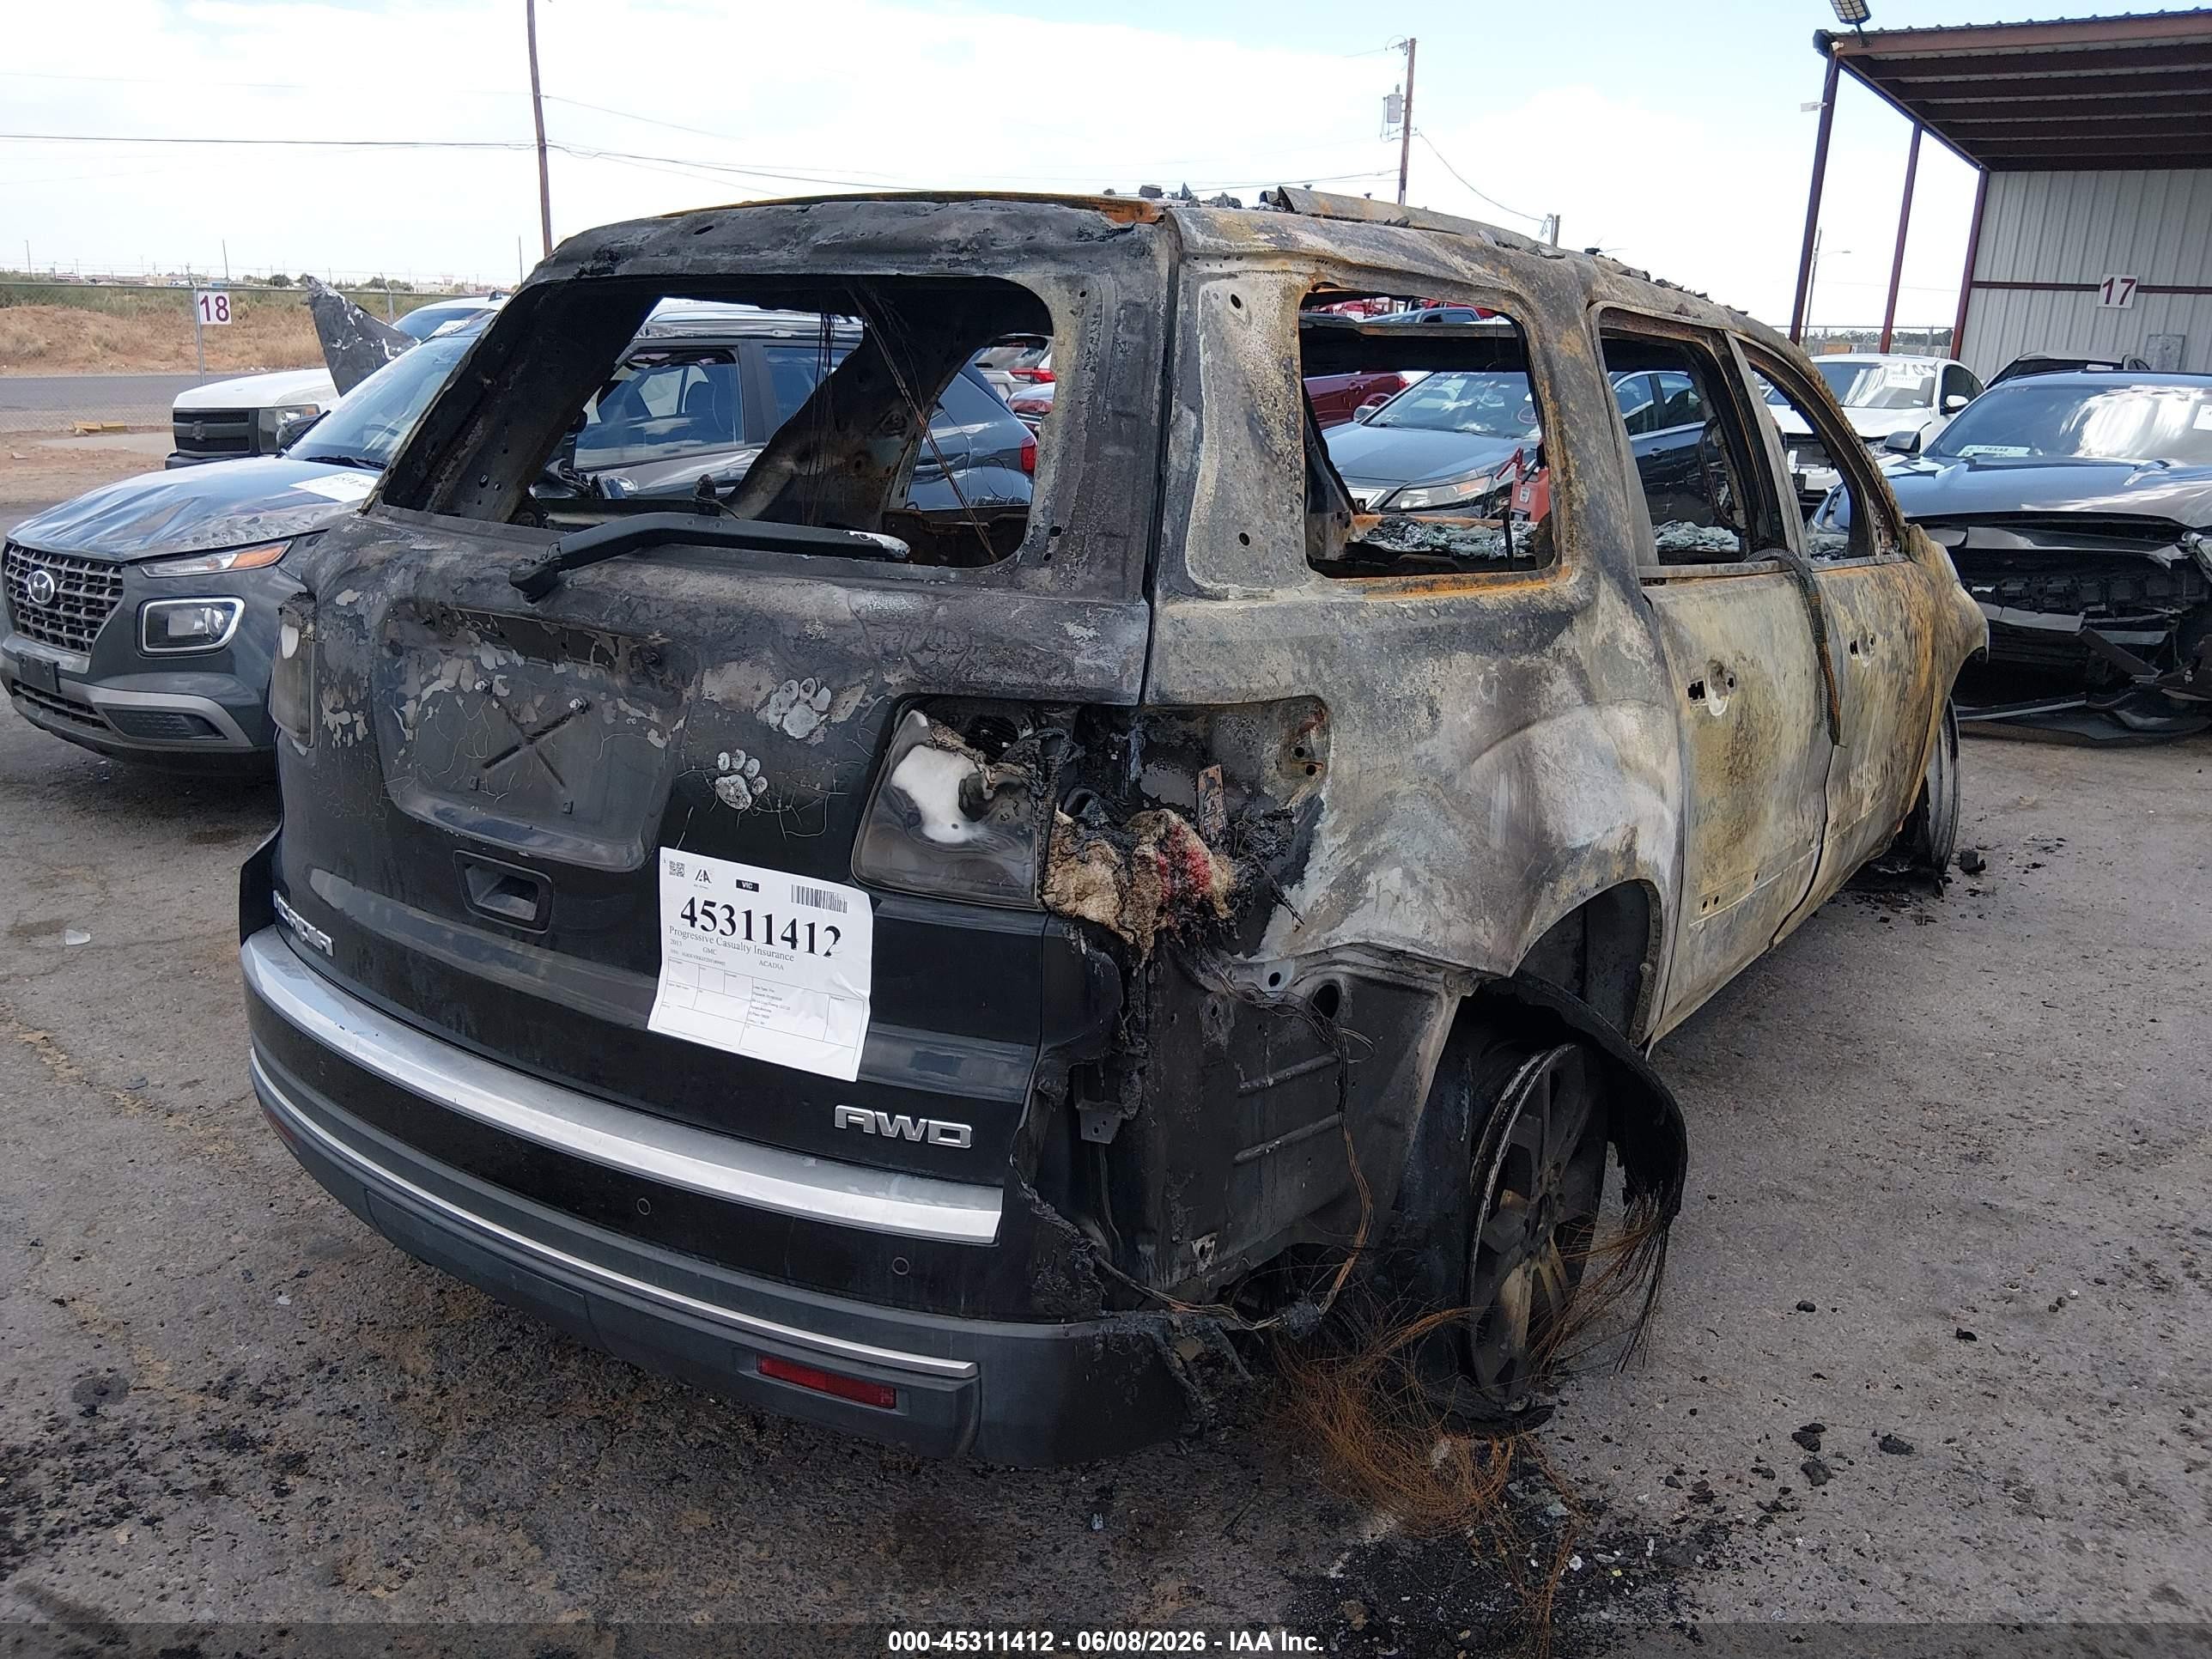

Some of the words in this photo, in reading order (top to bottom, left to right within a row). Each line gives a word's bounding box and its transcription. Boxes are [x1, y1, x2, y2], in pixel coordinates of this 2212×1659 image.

[2102, 277, 2136, 305] 17
[200, 295, 229, 322] 18
[680, 896, 842, 957] 45311412
[669, 926, 714, 945] Progressive
[715, 936, 752, 955] Casualty
[754, 945, 795, 962] Insurance
[758, 960, 785, 971] ACADIA
[835, 1105, 972, 1148] AWD
